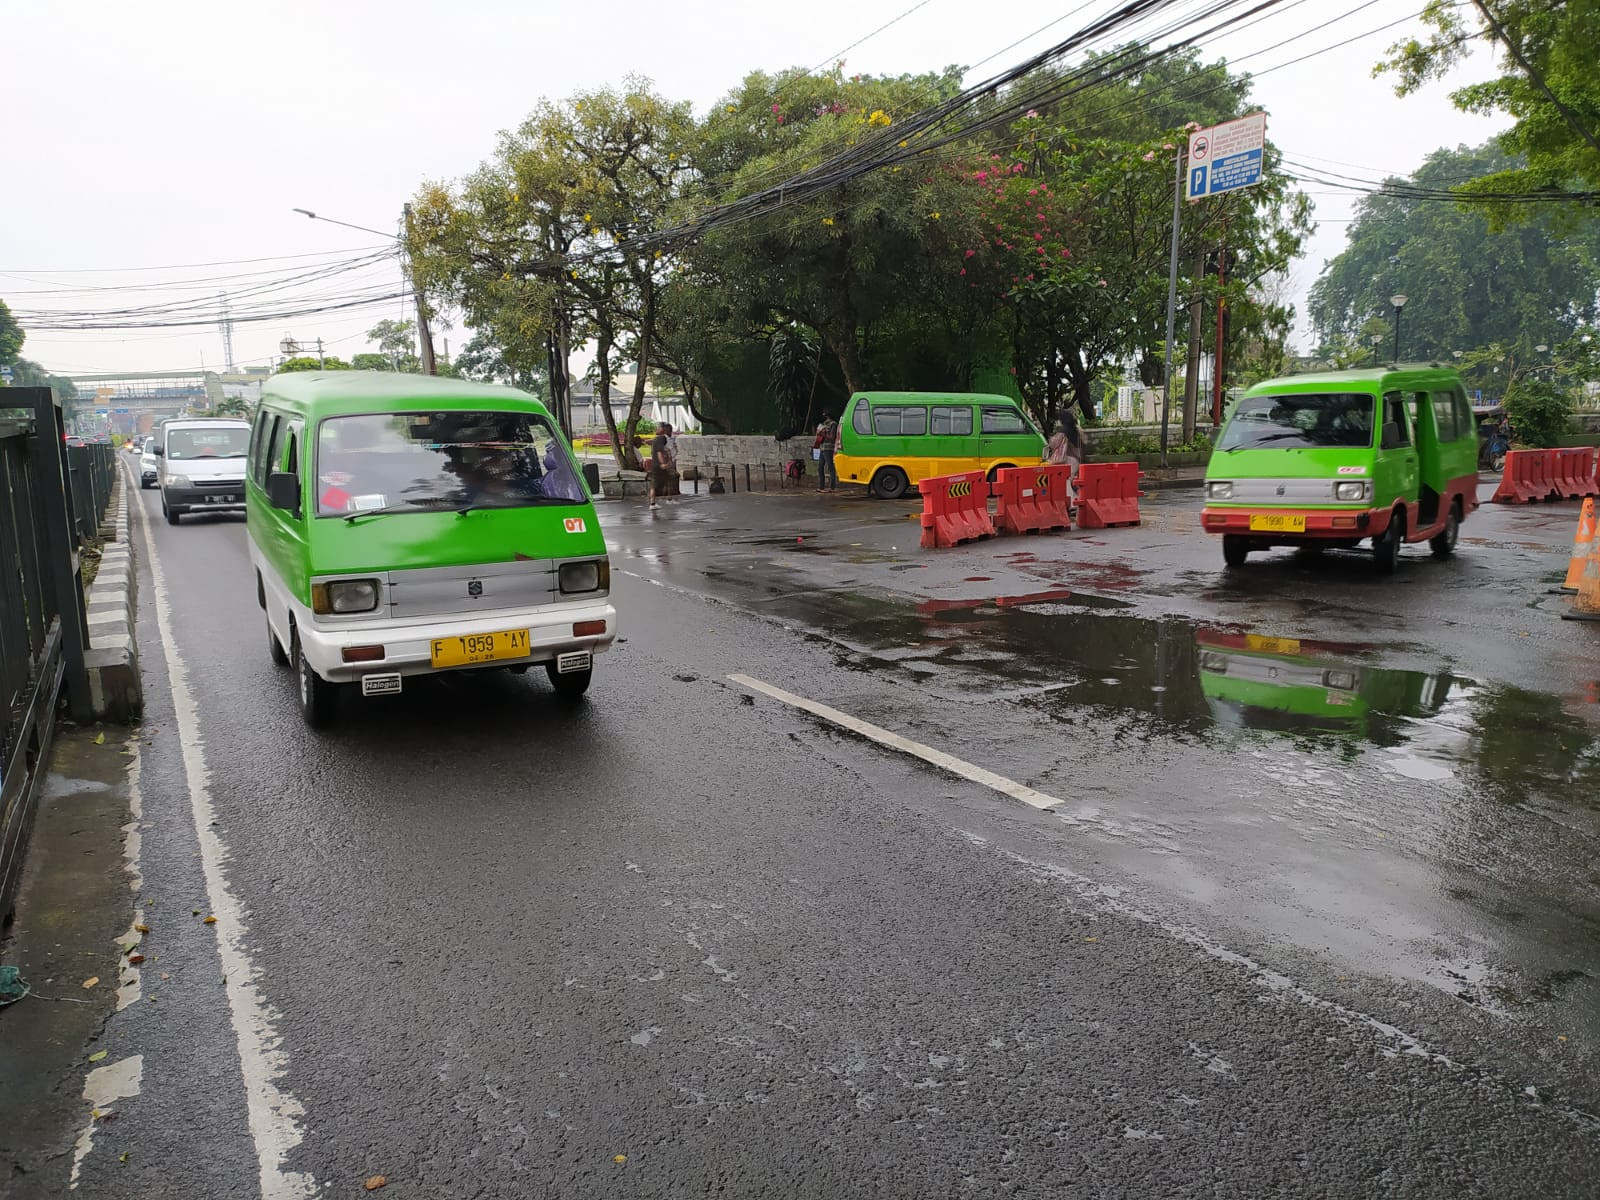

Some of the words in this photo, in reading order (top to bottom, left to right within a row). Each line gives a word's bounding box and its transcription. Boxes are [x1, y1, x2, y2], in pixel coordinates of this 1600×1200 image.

[1195, 170, 1203, 192] P
[565, 518, 583, 532] 07
[434, 641, 443, 659] F
[460, 635, 494, 654] 1959
[511, 631, 526, 648] AY
[366, 680, 399, 689] Halogen
